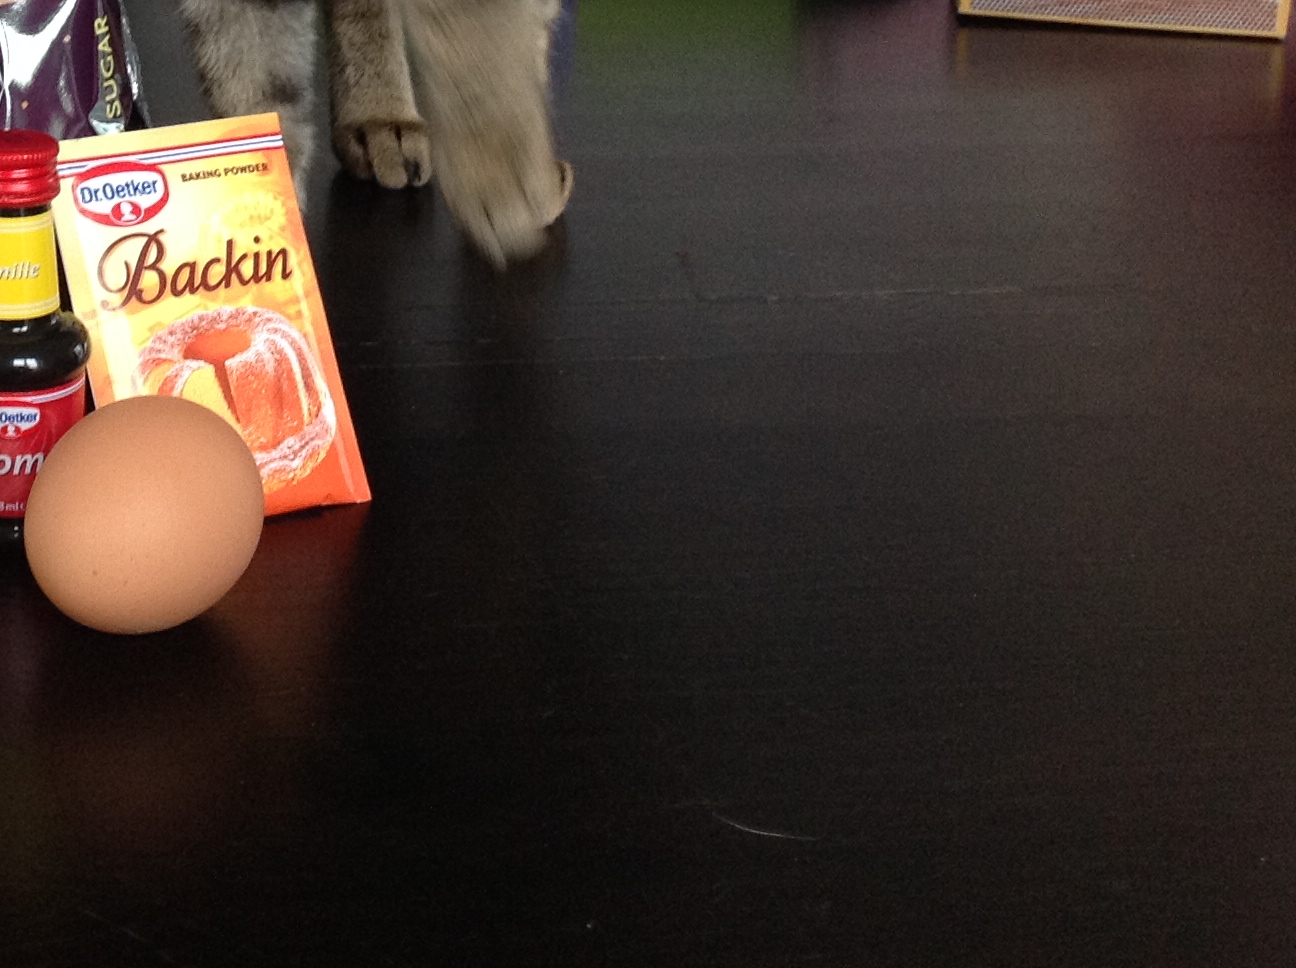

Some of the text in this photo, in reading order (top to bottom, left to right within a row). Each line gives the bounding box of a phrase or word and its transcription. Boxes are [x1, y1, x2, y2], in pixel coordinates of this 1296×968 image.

[93, 14, 122, 119] SUGAR
[181, 162, 268, 182] BAKING POWDER
[97, 229, 292, 312] Backin
